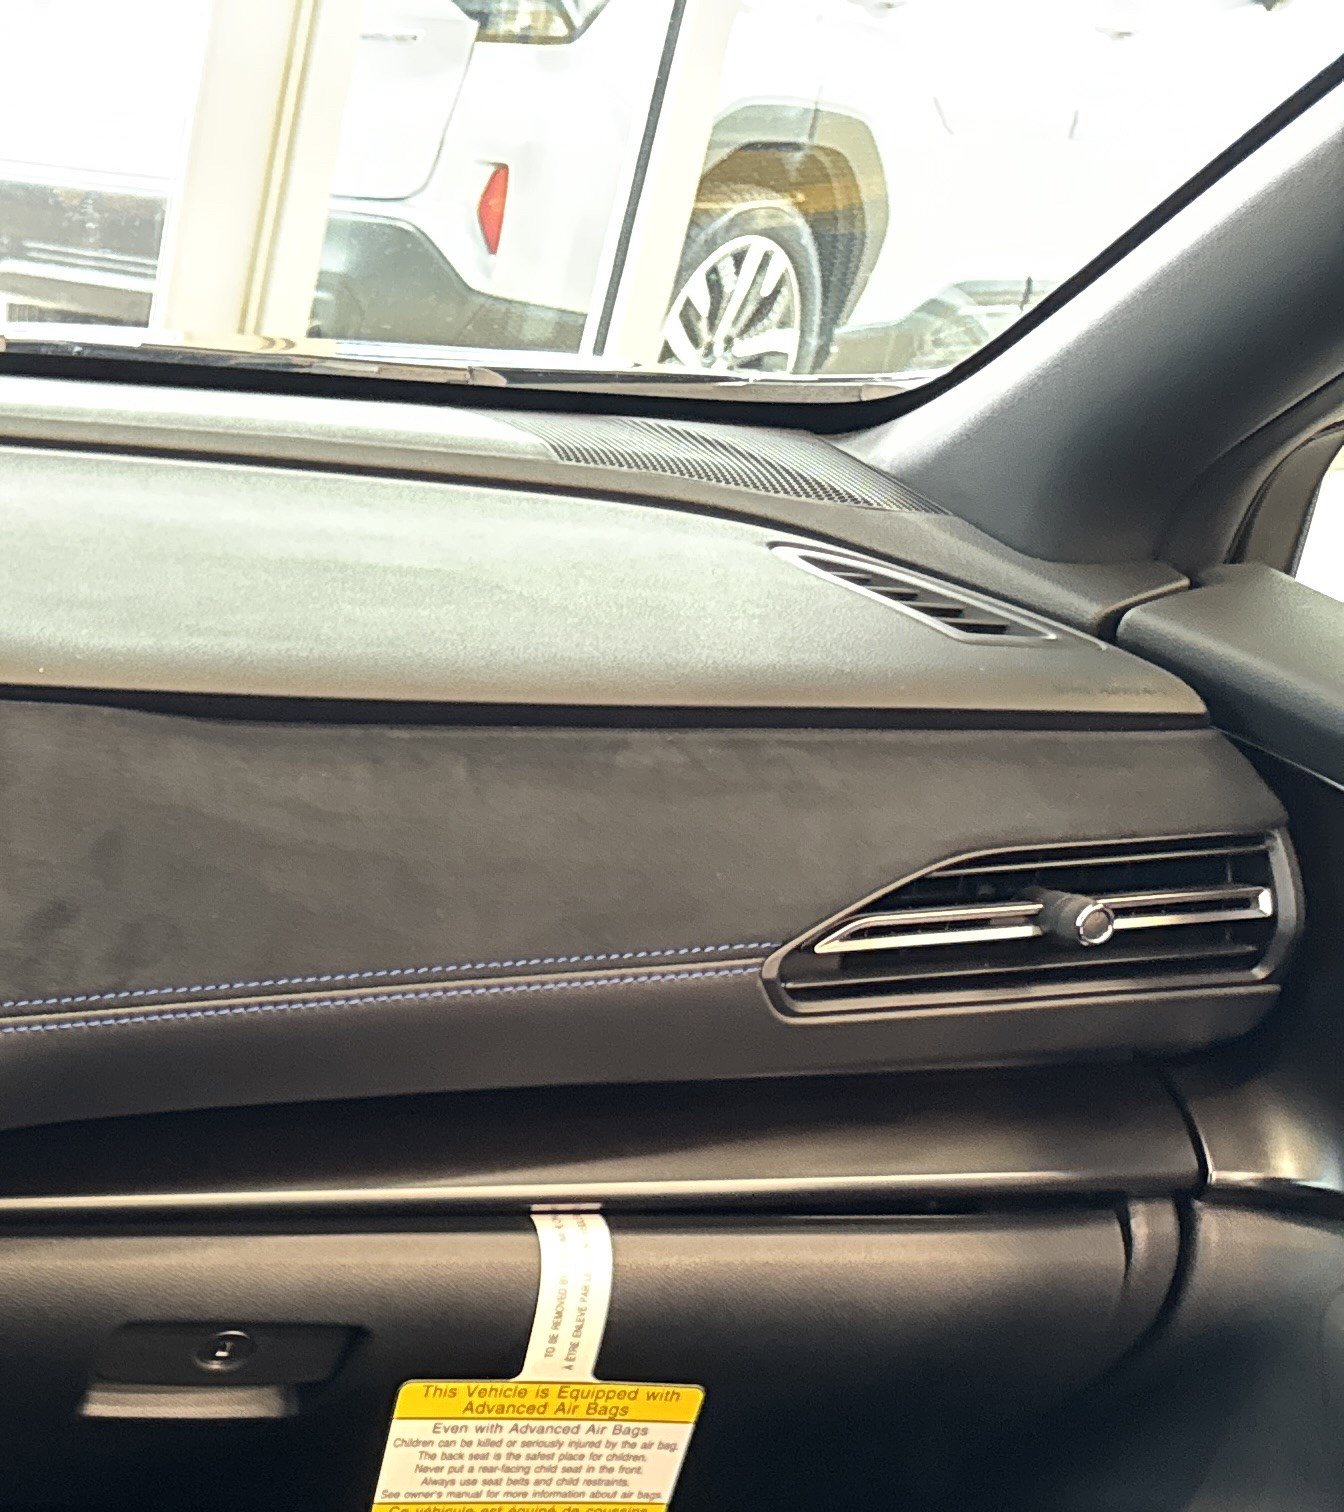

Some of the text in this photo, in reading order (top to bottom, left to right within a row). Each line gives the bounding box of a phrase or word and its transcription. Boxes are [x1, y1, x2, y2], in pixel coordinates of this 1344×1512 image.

[423, 1385, 681, 1402] This Vehicle is Equipped with
[462, 1401, 630, 1420] Advanced Air Bags
[432, 1422, 649, 1438] Even with Advanced Air Bags
[393, 1438, 434, 1448] Children
[438, 1439, 456, 1448] can
[460, 1438, 473, 1448] be
[477, 1438, 503, 1448] killed
[506, 1440, 517, 1448] or
[521, 1439, 564, 1450] seriously
[567, 1439, 602, 1450] injured
[604, 1440, 617, 1450] by
[621, 1440, 637, 1449] the
[640, 1441, 655, 1449] air
[418, 1451, 437, 1460] The
[441, 1451, 463, 1460] back
[468, 1452, 490, 1460] seat
[493, 1452, 502, 1460] is
[506, 1451, 521, 1460] the
[525, 1452, 555, 1461] safest
[558, 1452, 585, 1462] place
[589, 1452, 603, 1461] for
[414, 1464, 445, 1473] Never
[447, 1465, 465, 1474] put
[478, 1464, 531, 1475] rear-facing
[534, 1465, 558, 1473] child
[561, 1465, 583, 1474] seat
[586, 1465, 595, 1473] in
[599, 1465, 614, 1474] the
[421, 1477, 456, 1488] Always
[460, 1478, 478, 1487] use
[481, 1478, 503, 1487] seat
[506, 1477, 530, 1486] belts
[533, 1478, 553, 1487] and
[556, 1478, 580, 1487] child
[381, 1489, 400, 1499] See
[404, 1490, 442, 1499] owner's
[446, 1490, 483, 1499] manual
[486, 1489, 500, 1498] for
[503, 1490, 528, 1498] more
[532, 1489, 586, 1498] information
[589, 1490, 618, 1499] about
[620, 1491, 635, 1499] air
